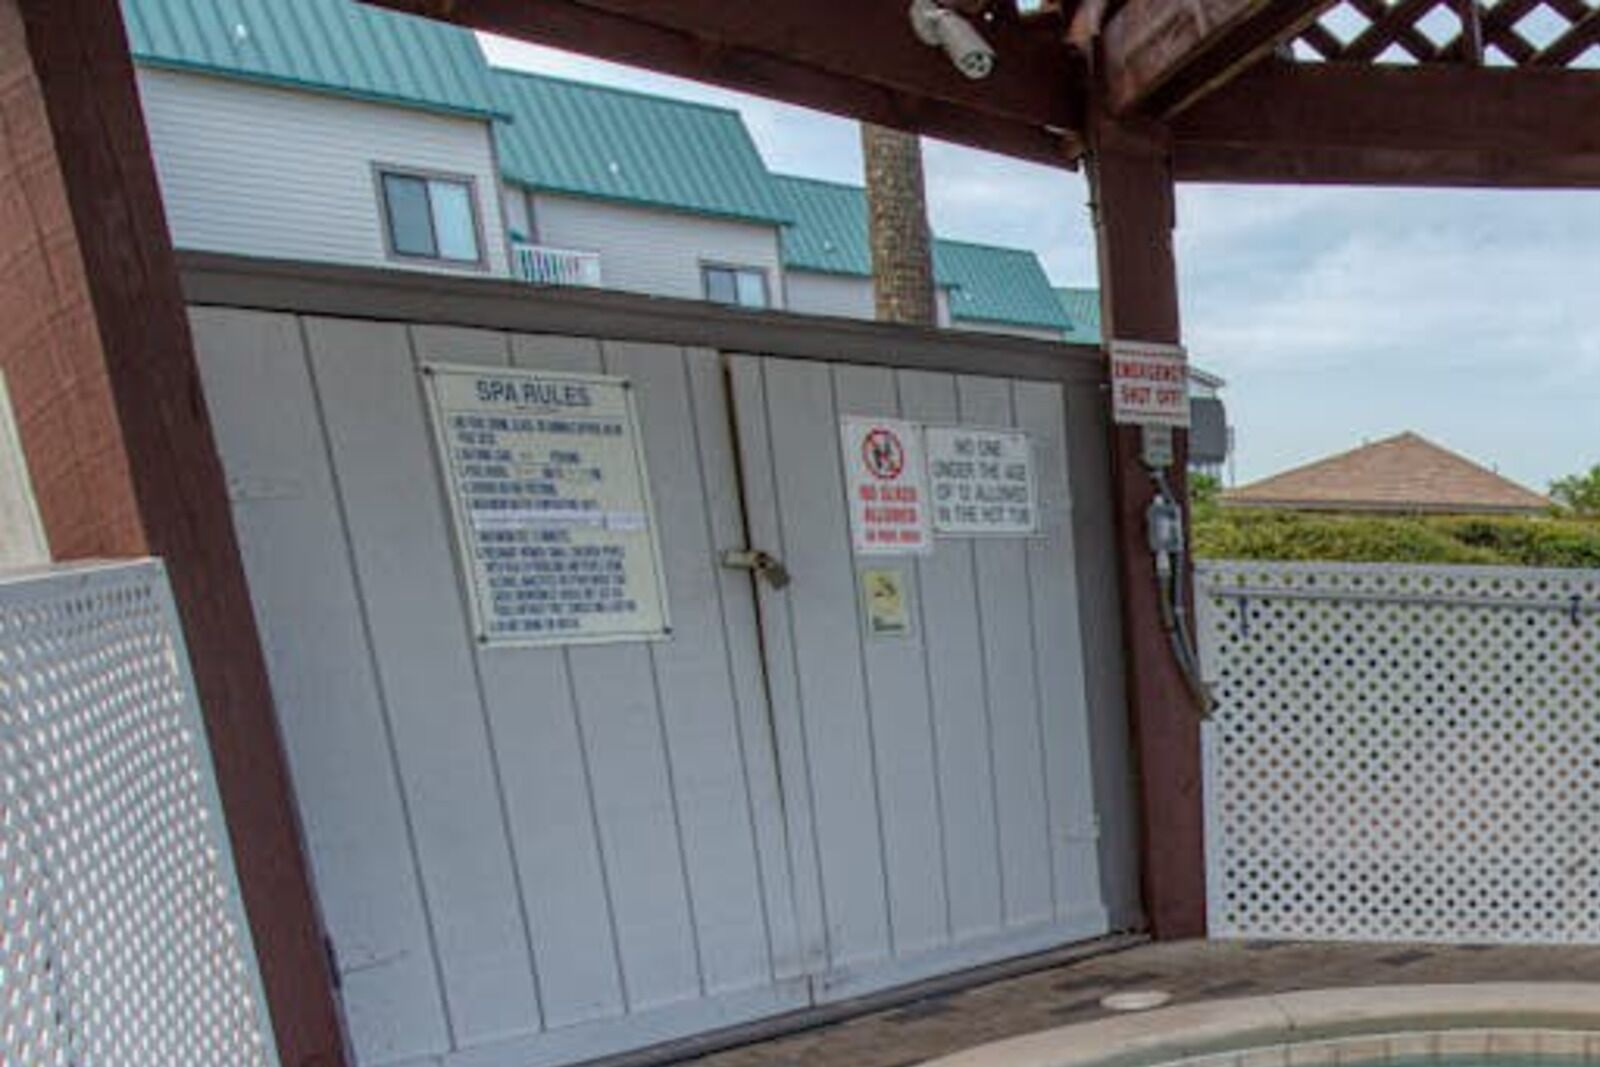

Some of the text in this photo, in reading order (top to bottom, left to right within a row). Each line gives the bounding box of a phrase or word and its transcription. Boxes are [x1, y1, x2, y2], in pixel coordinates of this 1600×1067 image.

[477, 380, 591, 406] SPA RULES
[954, 438, 1001, 457] NO ONE
[934, 461, 974, 478] UNDER
[979, 462, 999, 479] THE
[937, 483, 951, 500] OF
[975, 484, 1027, 503] ALLOWED
[955, 505, 977, 522] THE
[981, 506, 1003, 524] HOT
